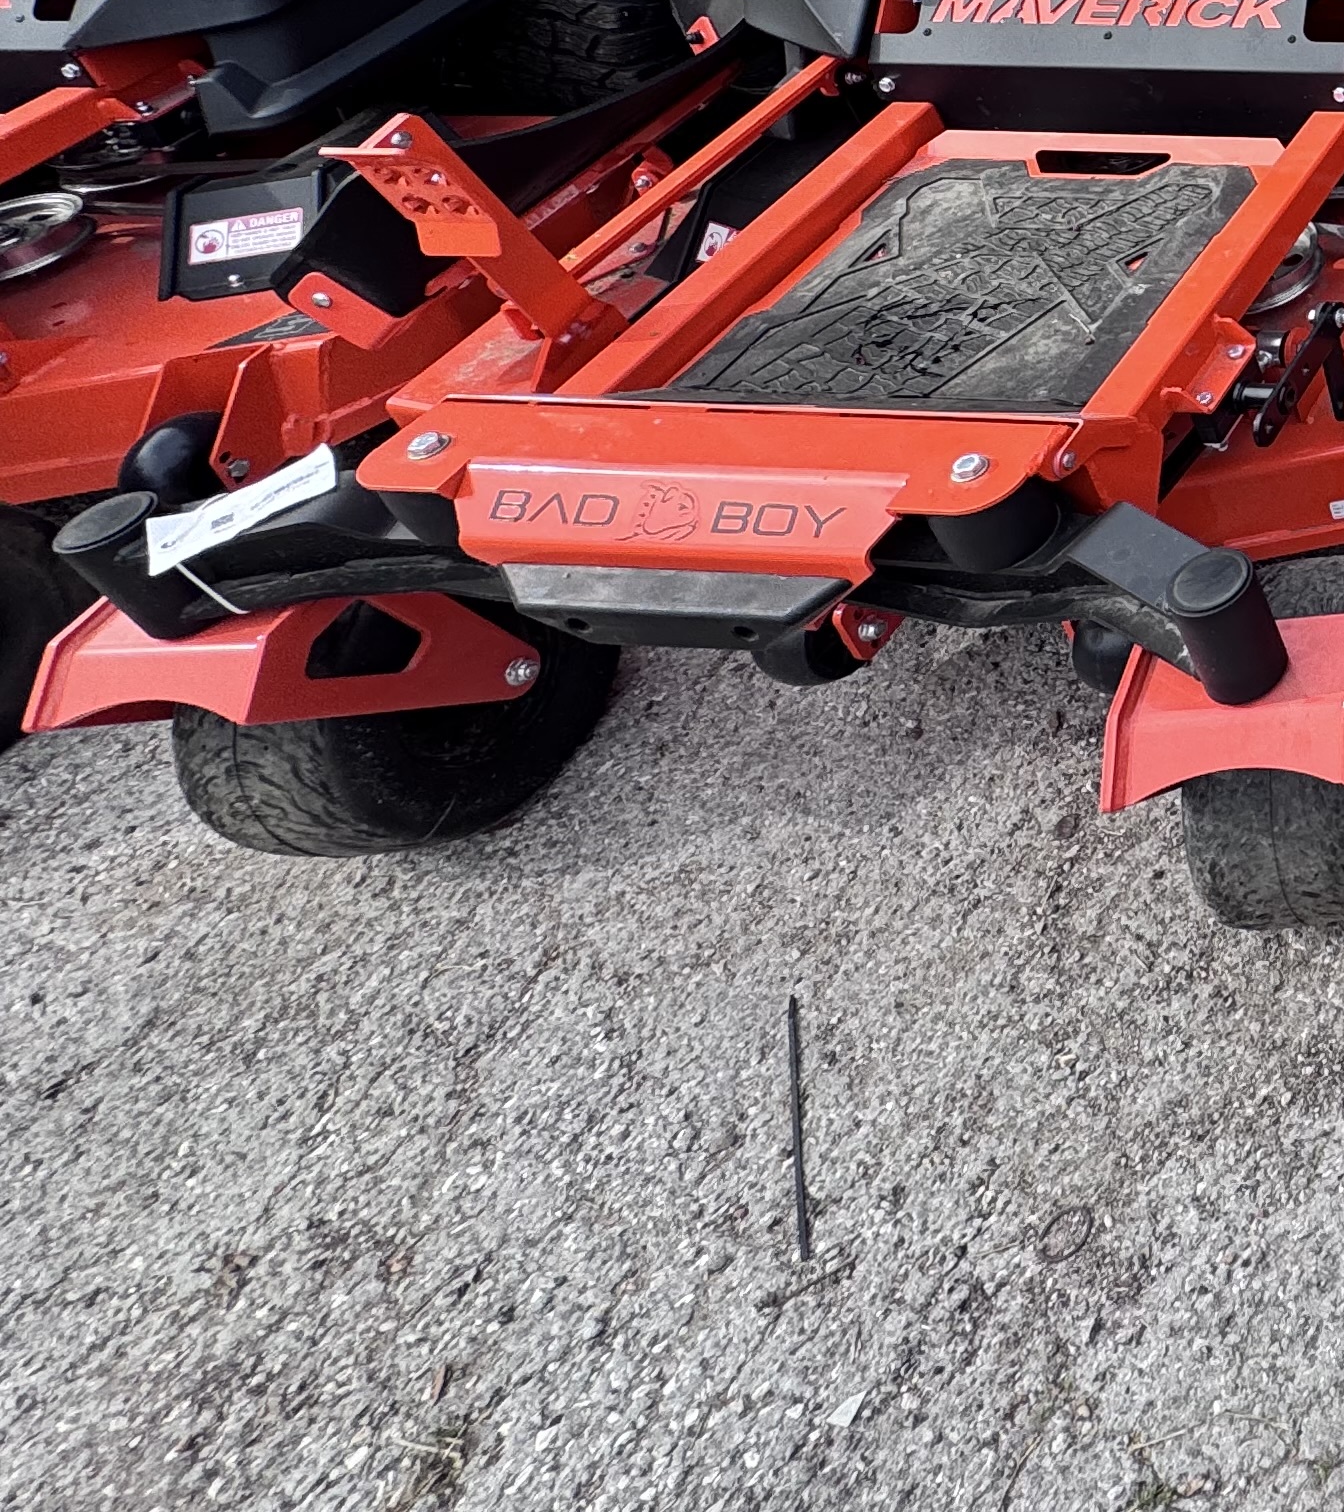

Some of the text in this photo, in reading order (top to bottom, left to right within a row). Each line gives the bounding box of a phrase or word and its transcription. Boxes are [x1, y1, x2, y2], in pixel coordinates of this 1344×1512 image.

[249, 211, 299, 228] DANGER
[488, 489, 847, 538] BAD BOY
